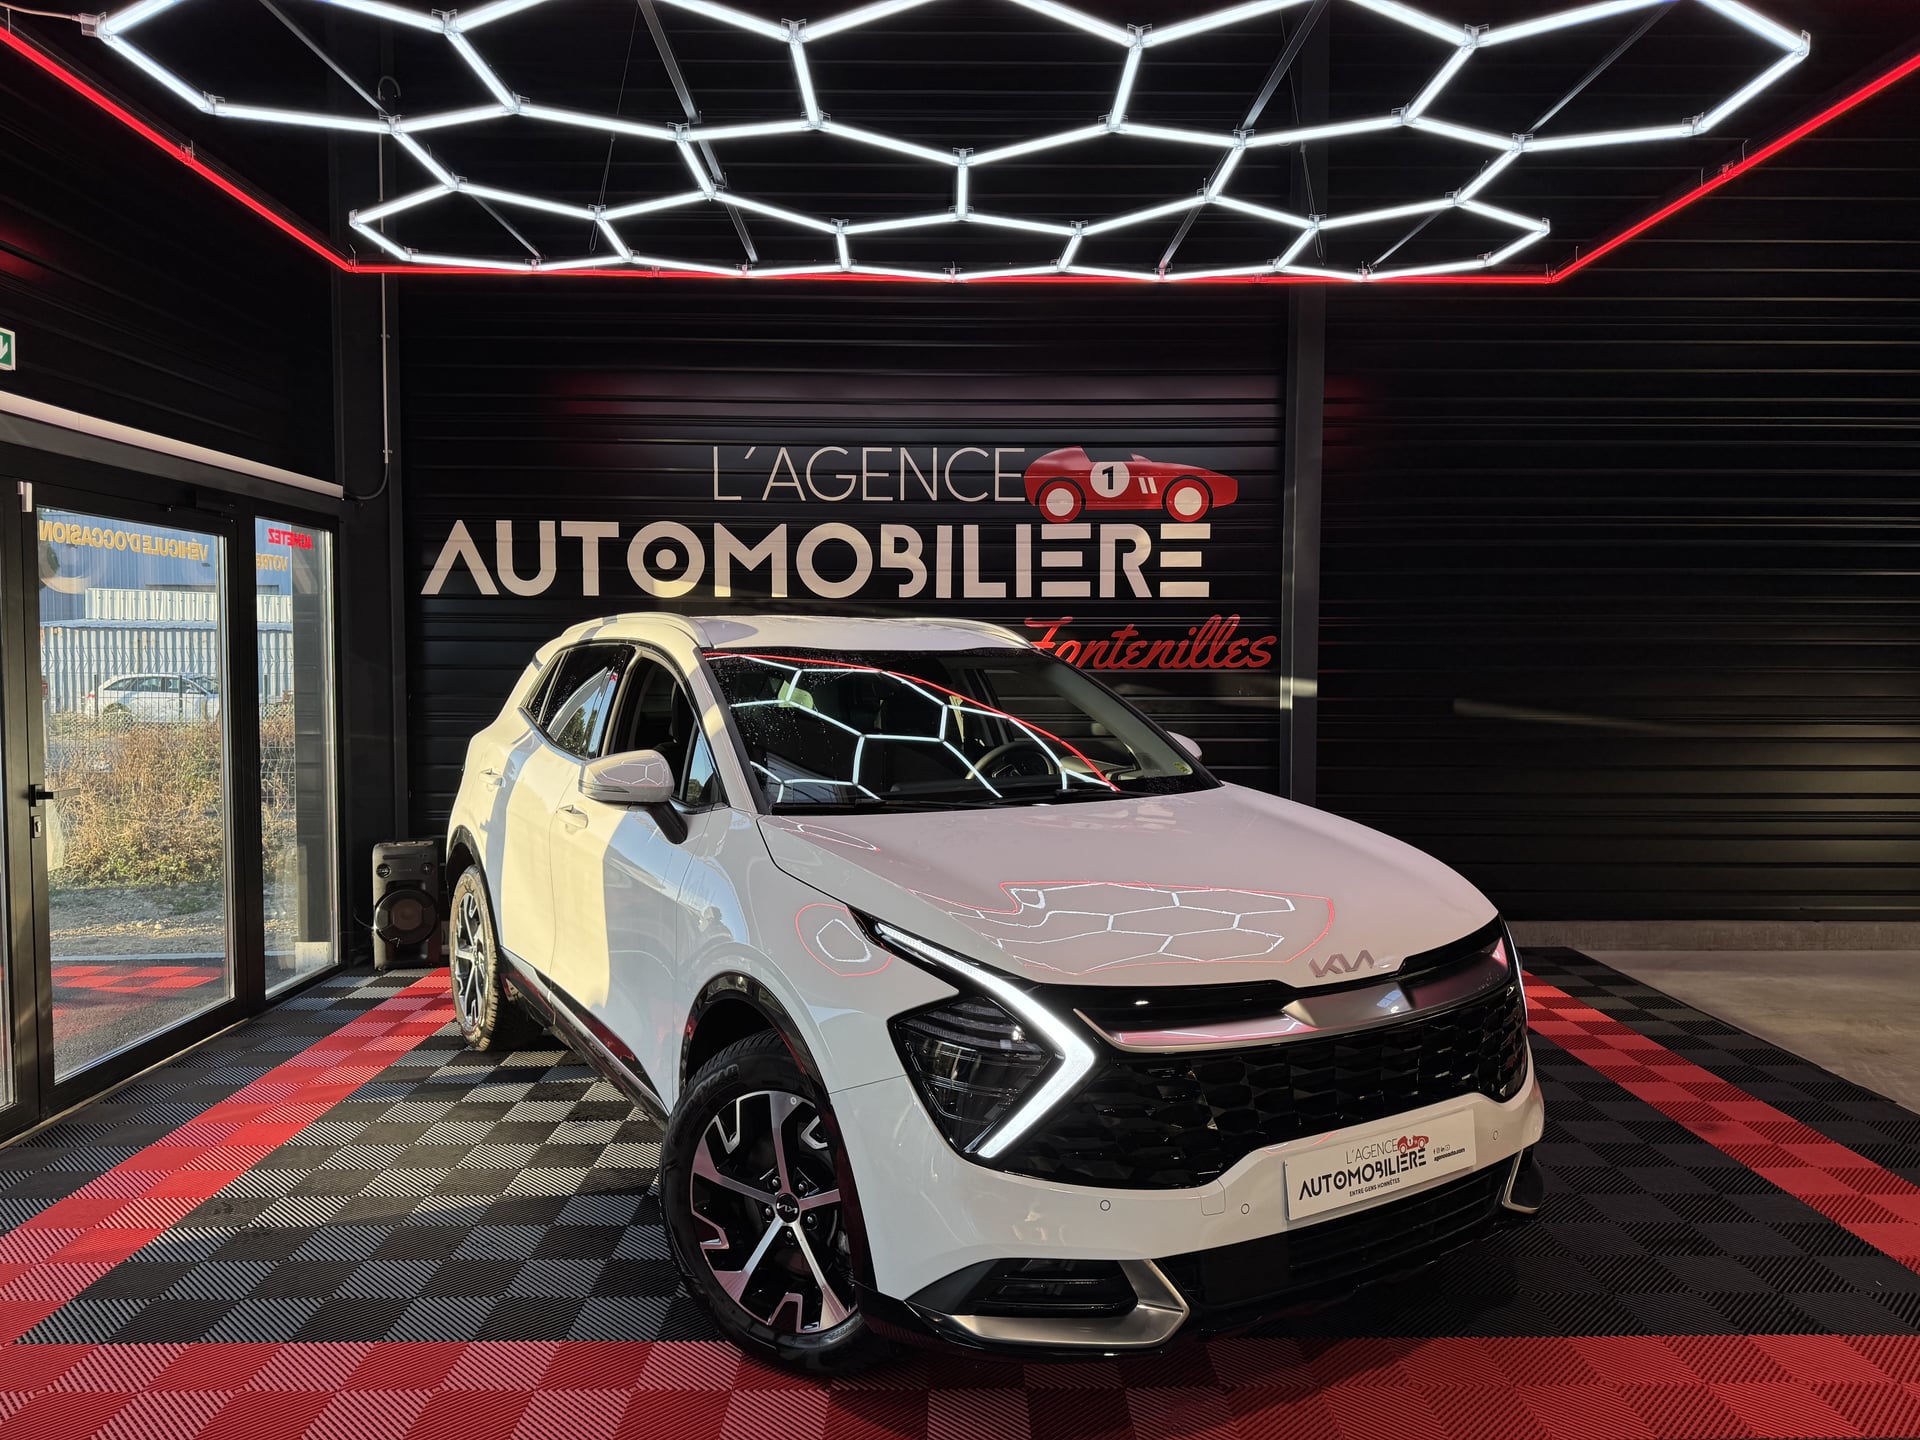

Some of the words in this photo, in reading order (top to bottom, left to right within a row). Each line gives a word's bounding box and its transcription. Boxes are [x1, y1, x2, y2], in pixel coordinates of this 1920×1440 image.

[713, 445, 1026, 503] L'AGENCE
[1101, 465, 1116, 491] 1
[1023, 614, 1278, 669] Fontenilles
[1308, 949, 1375, 978] KIA
[1349, 1188, 1364, 1197] ENTRE
[1364, 1184, 1377, 1192] GENS
